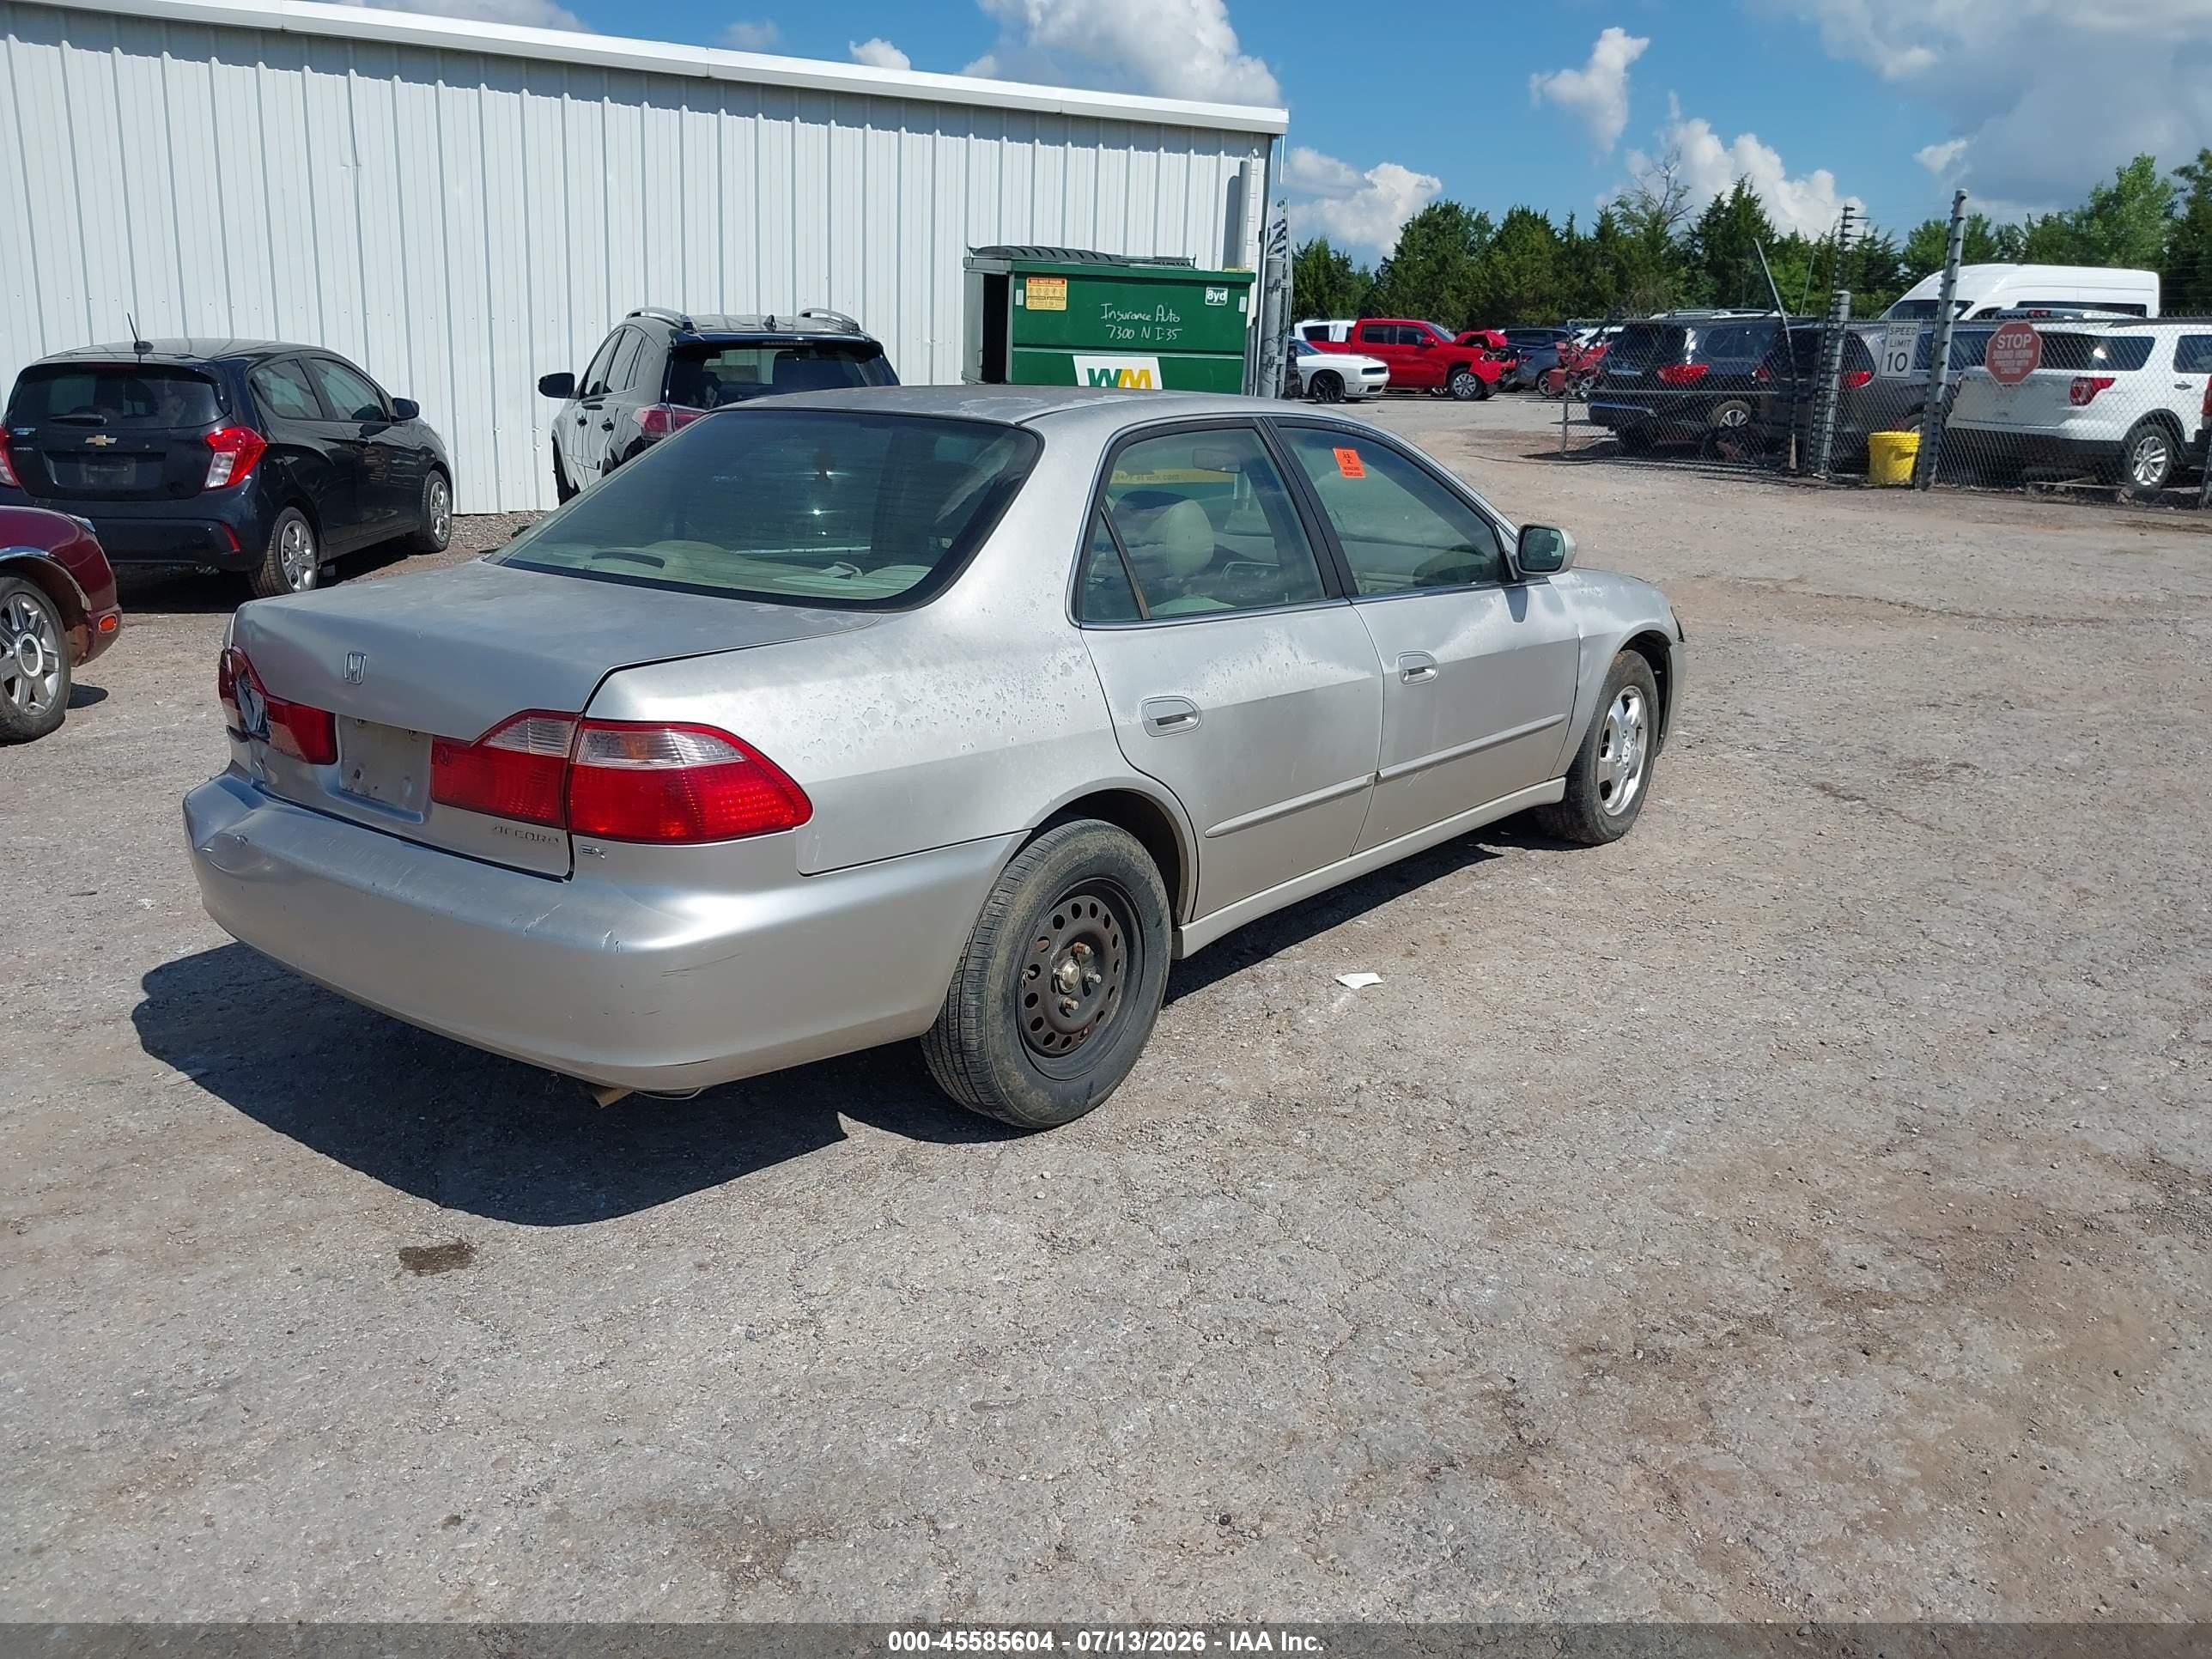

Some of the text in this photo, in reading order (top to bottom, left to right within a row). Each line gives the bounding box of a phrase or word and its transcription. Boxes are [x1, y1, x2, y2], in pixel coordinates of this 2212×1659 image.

[1207, 289, 1227, 303] 8yd
[1100, 302, 1181, 323] Insurance Auto
[1105, 325, 1182, 341] 7300 N I-35
[1889, 326, 1917, 336] SPEED
[1889, 338, 1912, 348] LIMIT
[1996, 333, 2033, 349] STOP
[1887, 351, 1908, 373] 10
[1086, 368, 1152, 388] WM
